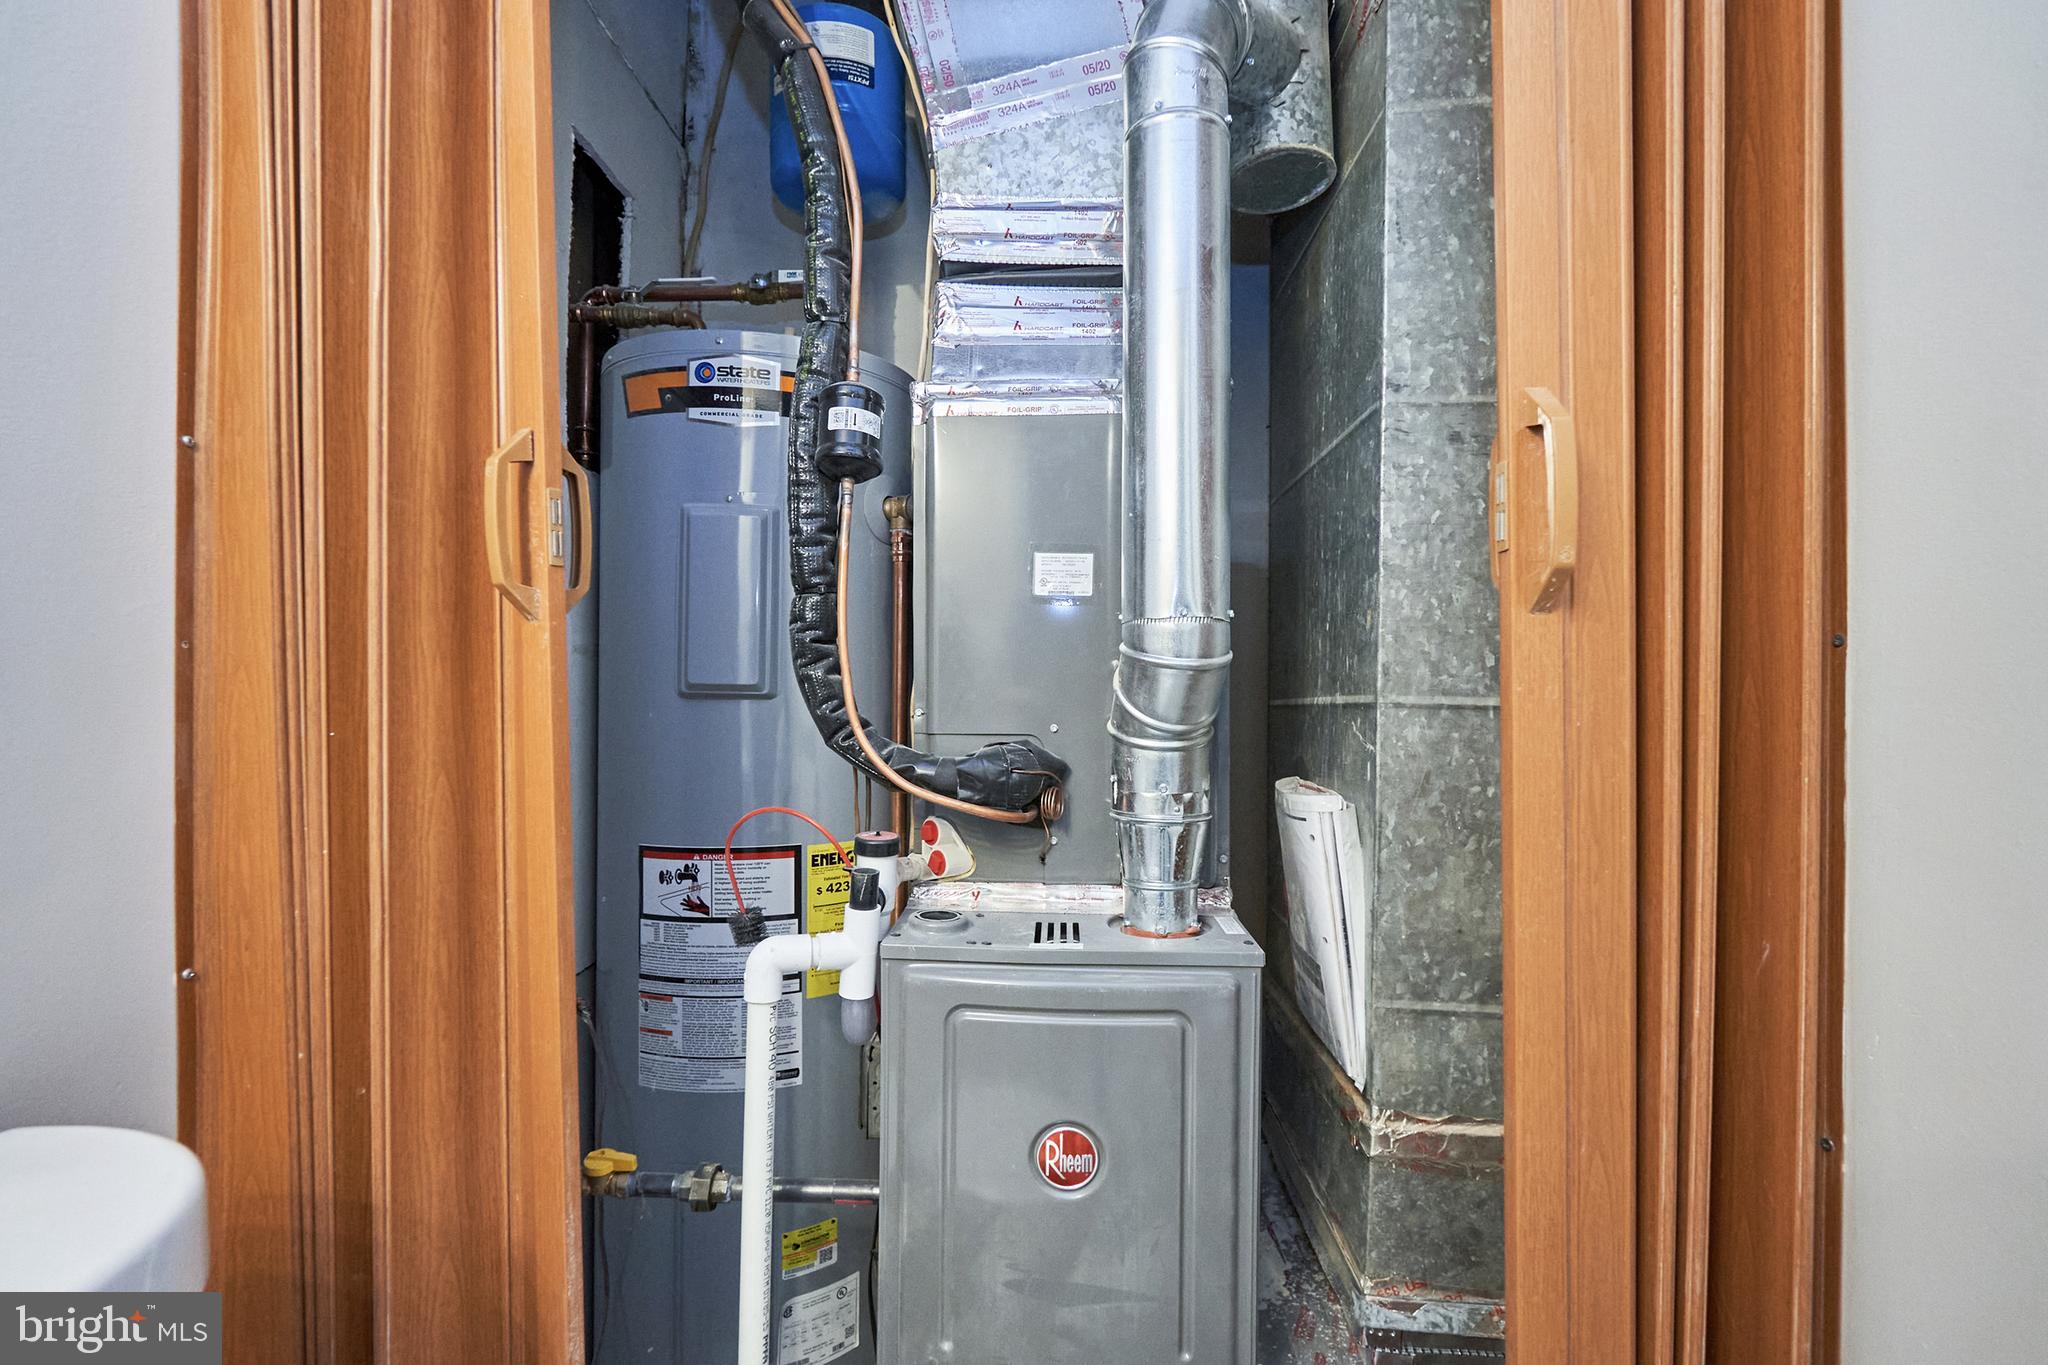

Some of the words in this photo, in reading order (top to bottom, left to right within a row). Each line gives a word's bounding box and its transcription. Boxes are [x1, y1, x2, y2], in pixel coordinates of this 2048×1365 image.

[940, 59, 955, 88] 05/20
[1082, 59, 1111, 76] 05/20
[992, 79, 1021, 96] 324A
[1088, 80, 1117, 97] 05/20
[998, 102, 1028, 118] 324A
[717, 365, 771, 380] state
[713, 393, 752, 403] ProLine
[811, 850, 856, 868] ENERG
[826, 880, 850, 893] 423
[769, 1005, 777, 1023] PVC
[768, 1026, 777, 1052] SCH
[767, 1054, 777, 1071] 40
[1045, 1132, 1093, 1180] Rheem
